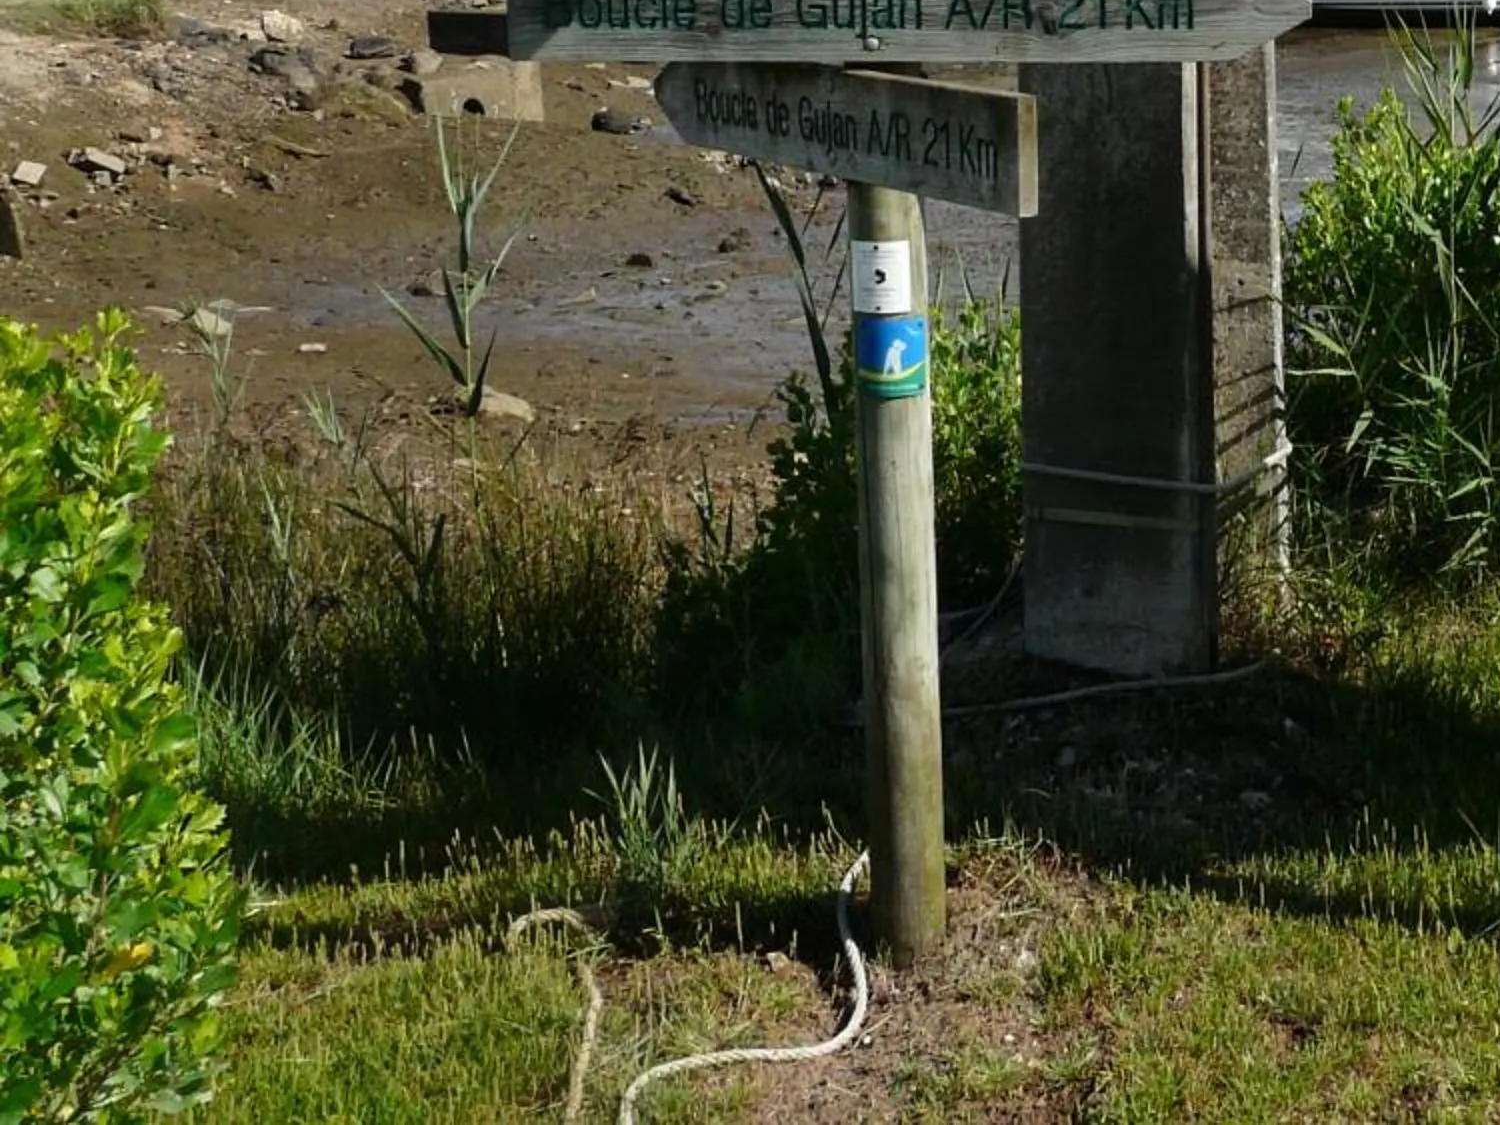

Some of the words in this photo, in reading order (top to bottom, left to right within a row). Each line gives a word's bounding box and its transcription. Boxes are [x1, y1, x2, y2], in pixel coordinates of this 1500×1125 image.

[694, 84, 759, 133] Boucle
[765, 94, 790, 138] de
[798, 94, 858, 157] Gujan
[866, 107, 911, 163] A/R
[921, 120, 951, 171] 21
[958, 123, 999, 183] Km
